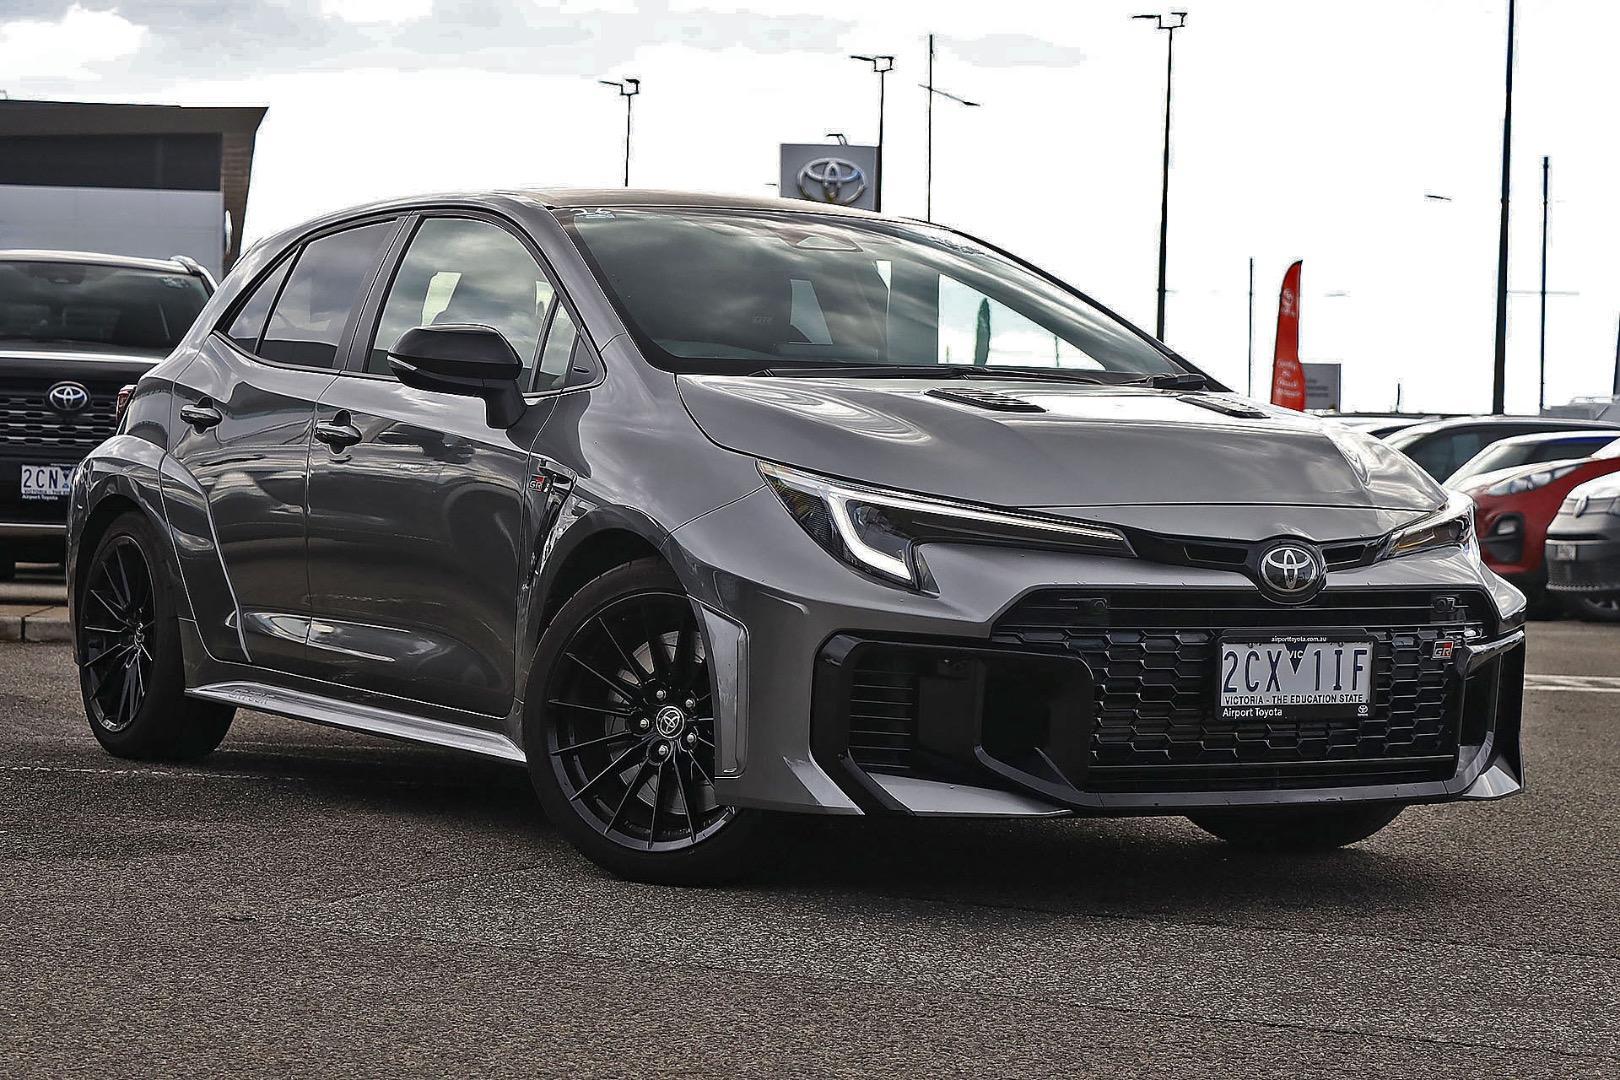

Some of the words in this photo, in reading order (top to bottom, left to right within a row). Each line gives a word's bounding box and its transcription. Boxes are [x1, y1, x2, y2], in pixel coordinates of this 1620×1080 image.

[23, 468, 58, 489] 2CN
[1289, 650, 1304, 659] VIC
[1223, 650, 1282, 692] 2CX
[1224, 695, 1264, 705] VICTORIA
[1272, 694, 1288, 704] THE
[1290, 694, 1337, 704] EDUCATION
[1339, 693, 1363, 703] STATE
[1222, 707, 1254, 720] Airport
[1254, 707, 1283, 719] Toyota
